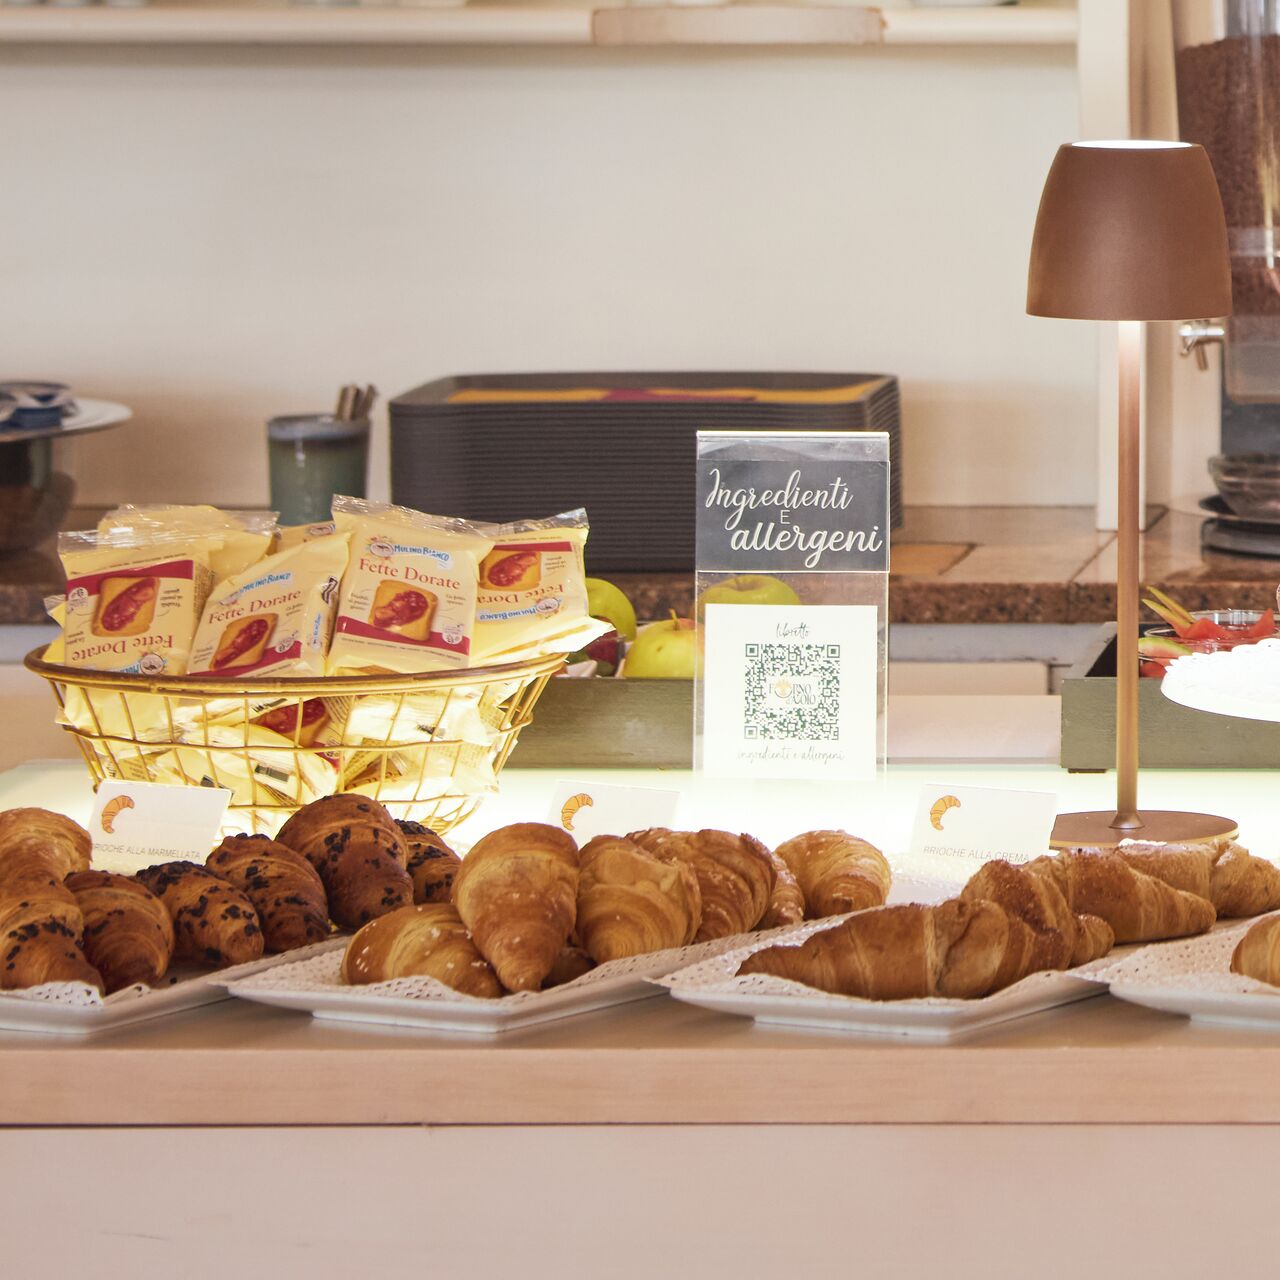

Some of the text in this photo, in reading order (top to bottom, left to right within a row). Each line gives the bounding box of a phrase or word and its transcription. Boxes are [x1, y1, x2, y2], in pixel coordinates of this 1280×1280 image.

[705, 468, 853, 531] Ingredienti
[780, 509, 791, 525] E
[730, 522, 883, 568] allergeni
[358, 557, 462, 590] Fette Dorate
[208, 606, 245, 625] Fette
[250, 590, 302, 613] Dorate
[477, 592, 519, 605] Dora
[776, 622, 812, 639] libretto
[72, 634, 174, 662] Fette Dorate
[93, 842, 125, 854] RIOCHE
[126, 846, 146, 855] ALLA
[968, 849, 992, 860] ALLA
